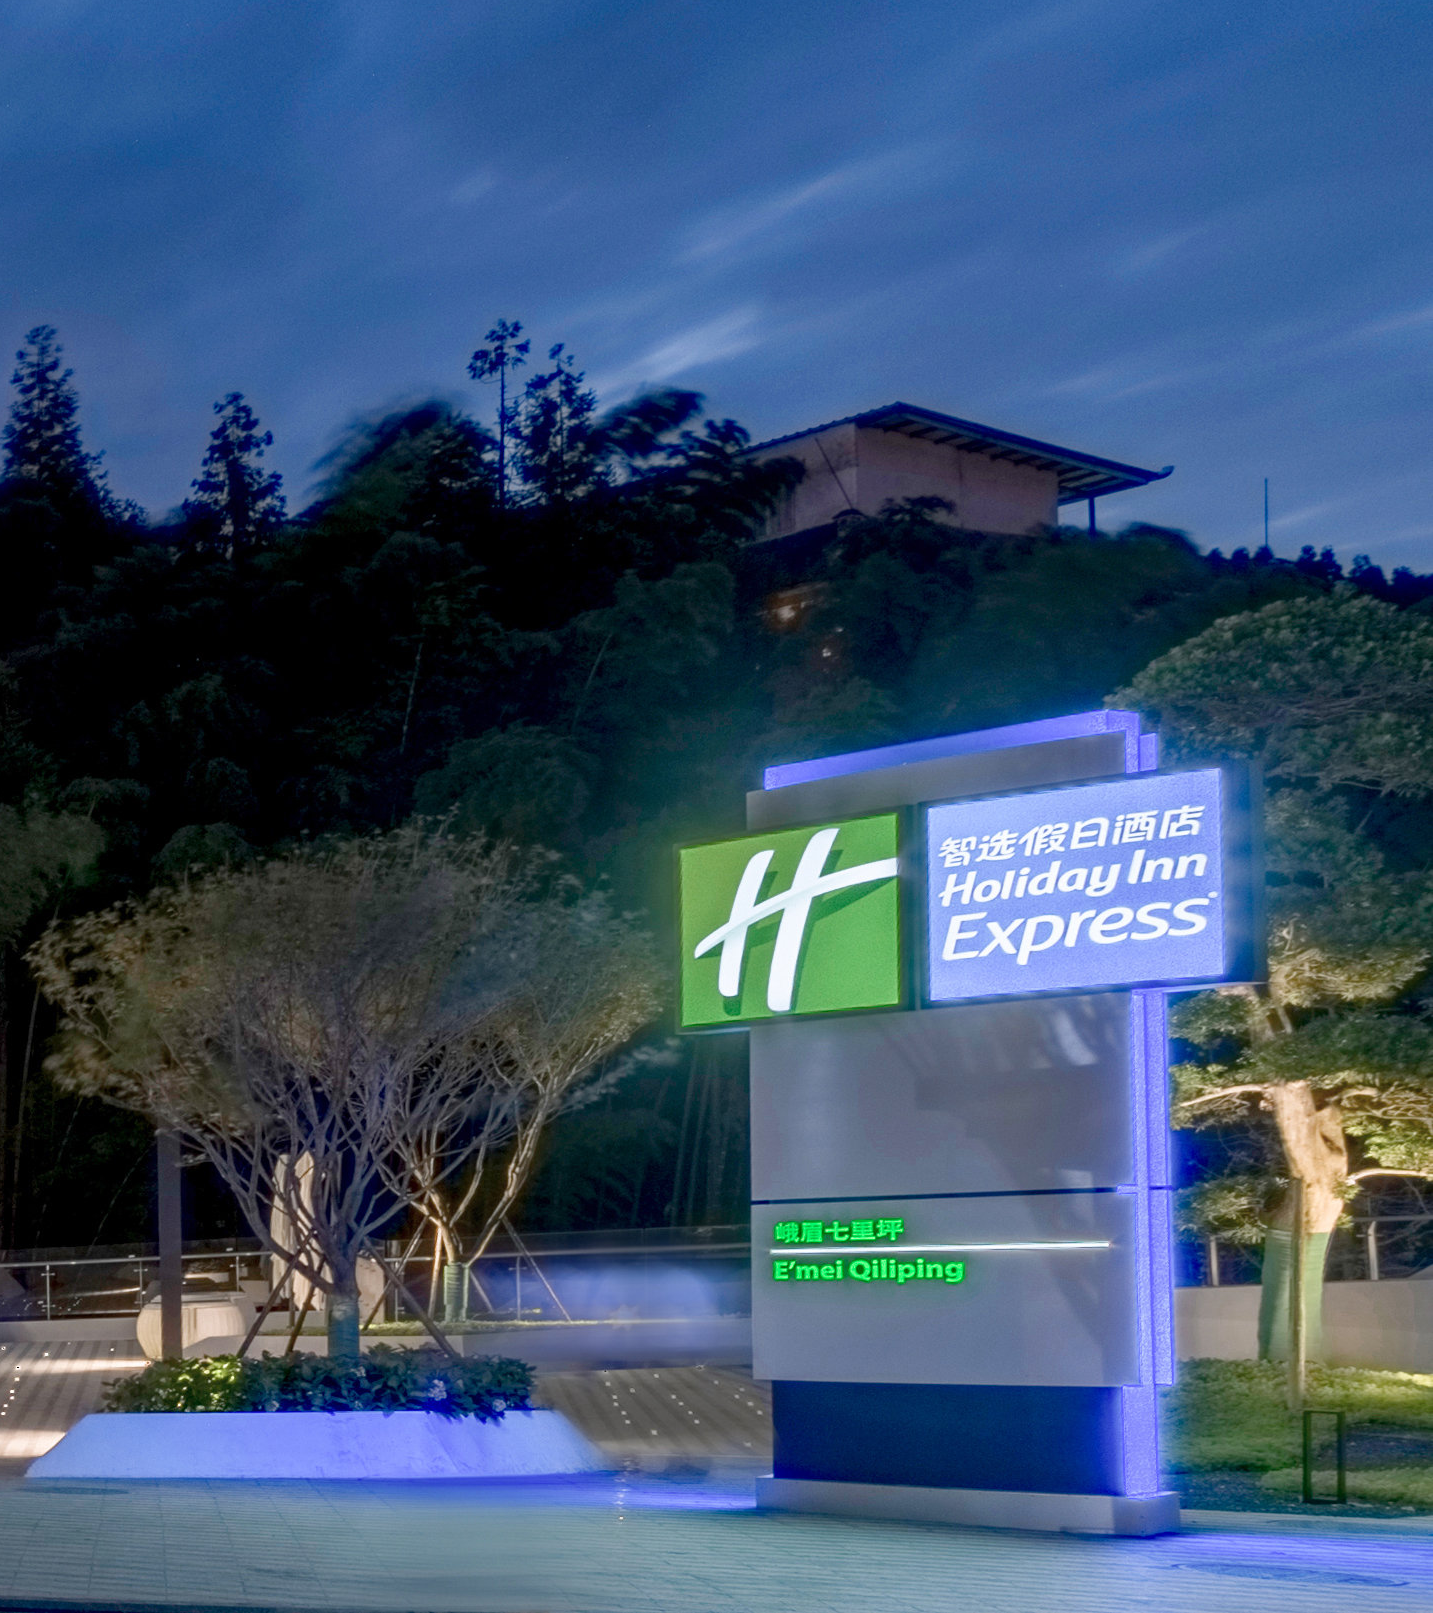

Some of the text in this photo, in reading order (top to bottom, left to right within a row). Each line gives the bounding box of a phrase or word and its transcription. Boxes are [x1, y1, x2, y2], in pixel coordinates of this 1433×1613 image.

[938, 803, 1206, 869] 智选假日酒店
[938, 849, 1206, 908] Holiday Inn
[941, 896, 1210, 966] Express
[774, 1218, 904, 1243] 峨眉七里坪
[773, 1258, 965, 1284] E'mei Qiliping
